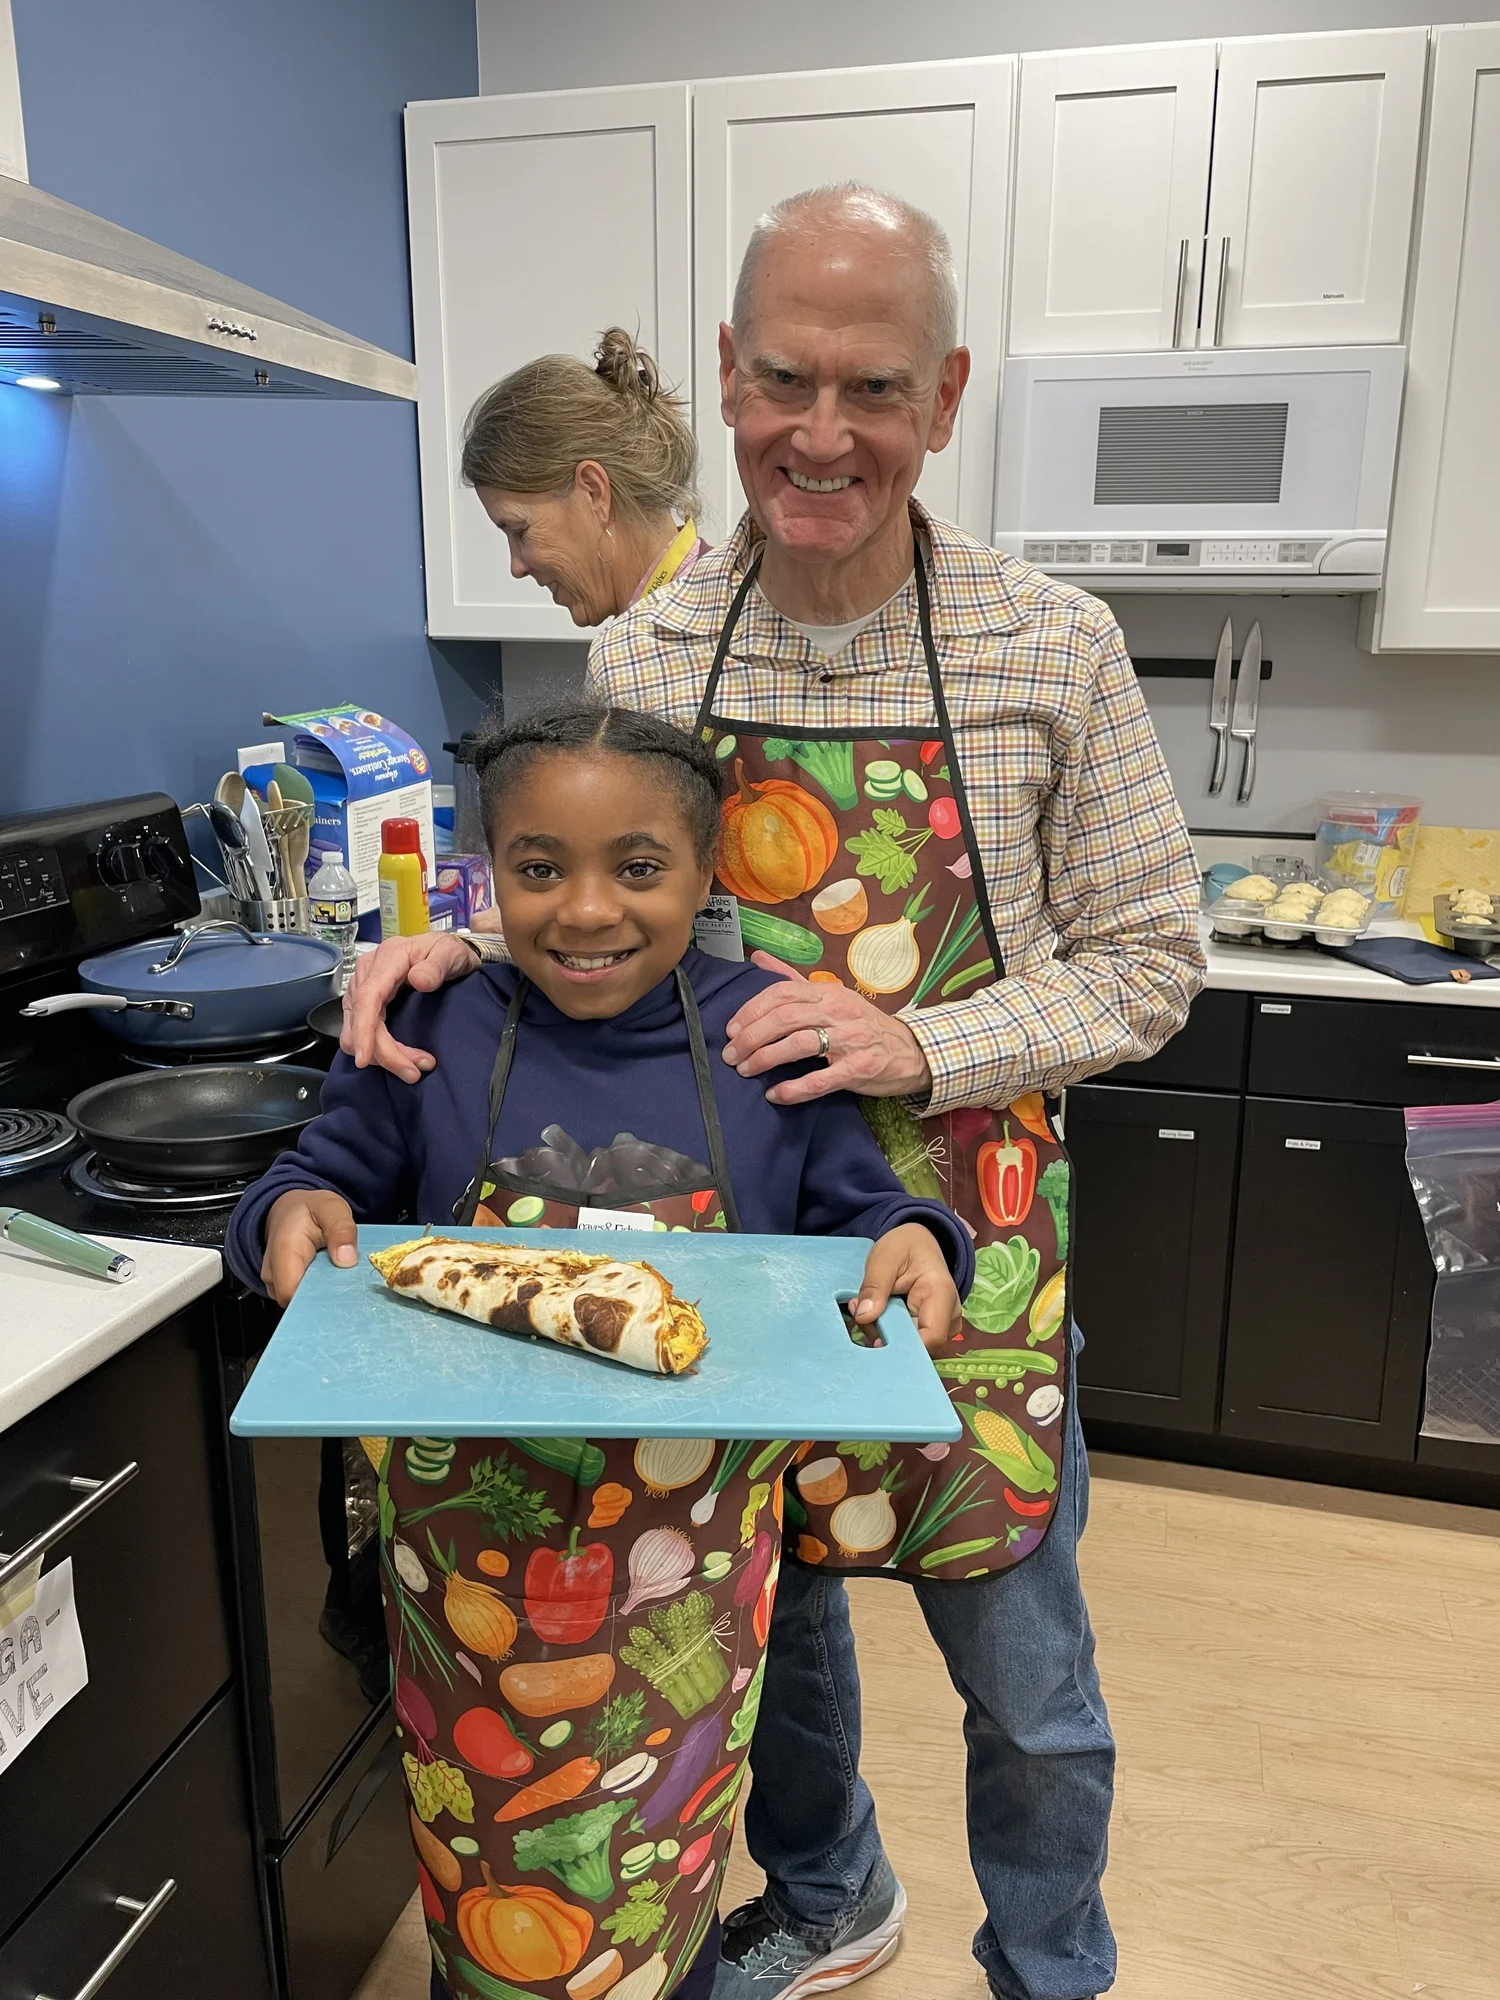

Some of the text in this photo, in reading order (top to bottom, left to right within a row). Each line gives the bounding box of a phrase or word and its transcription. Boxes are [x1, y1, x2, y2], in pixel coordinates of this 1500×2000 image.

[387, 753, 411, 766] Storage
[350, 759, 388, 776] Containers
[314, 815, 342, 825] ainers
[0, 1662, 55, 1756] VE
